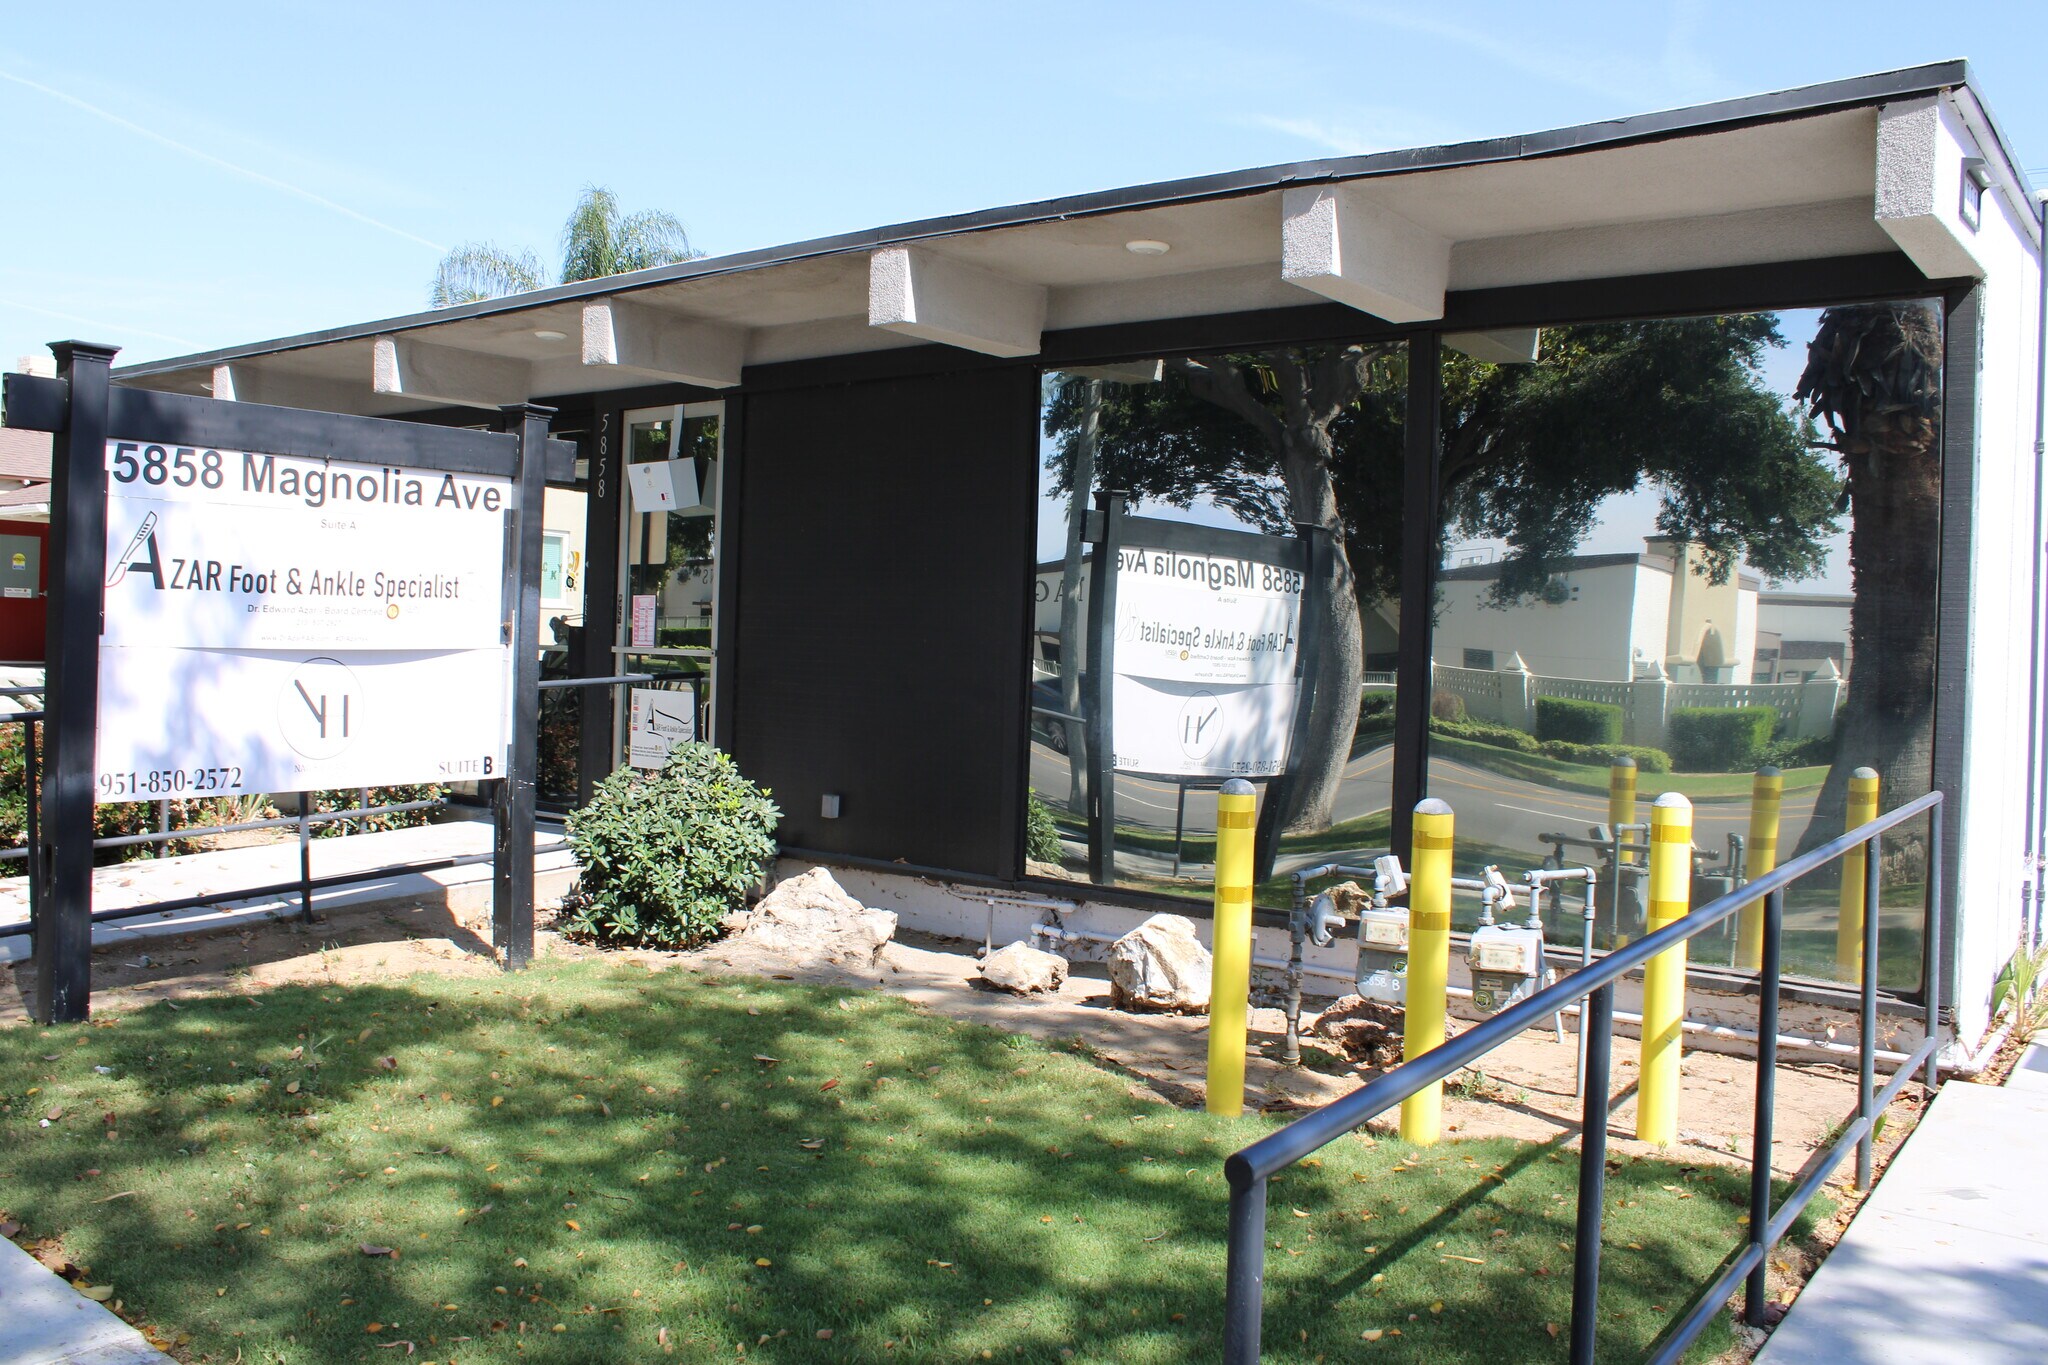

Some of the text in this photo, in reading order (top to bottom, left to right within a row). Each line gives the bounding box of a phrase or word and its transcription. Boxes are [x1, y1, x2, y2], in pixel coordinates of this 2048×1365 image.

[598, 413, 609, 498] 5858
[112, 442, 501, 512] 5858 Magnolia Ave
[320, 517, 357, 531] Suite A
[229, 565, 277, 595] Foot
[286, 567, 304, 596] &
[309, 570, 365, 598] Ankle
[374, 572, 460, 604] Specialist
[247, 604, 260, 613] Dr.
[263, 605, 296, 614] Edward
[324, 606, 349, 615] Board
[351, 607, 383, 616] Certified
[438, 756, 493, 775] SUITE B
[100, 767, 242, 796] 951-850-2572
[1392, 979, 1400, 991] B
